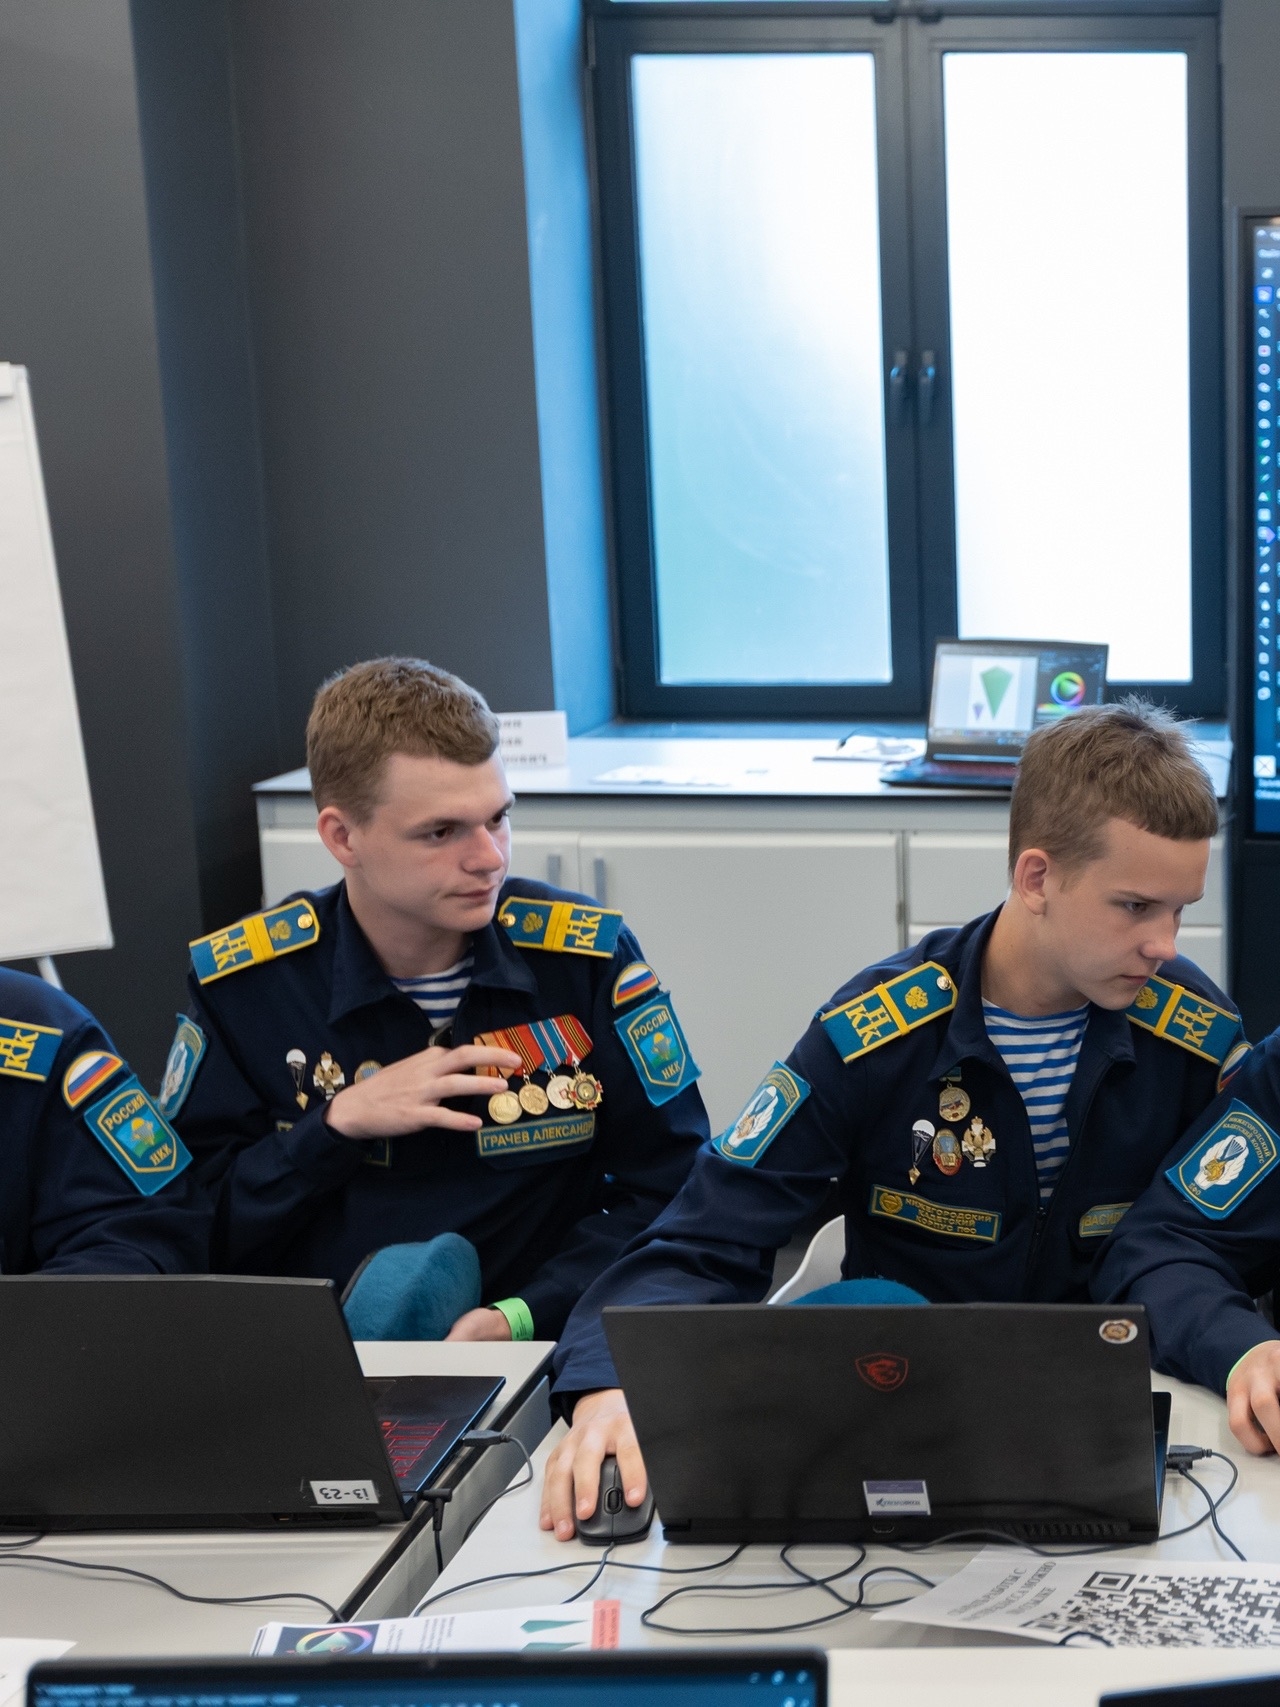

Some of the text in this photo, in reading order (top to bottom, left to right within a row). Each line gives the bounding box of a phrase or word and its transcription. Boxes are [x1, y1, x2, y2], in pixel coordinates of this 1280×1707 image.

[104, 1093, 148, 1131] РОССИЯ
[483, 1121, 594, 1149] ГРАЧЕВ АЛЕКСАНДР
[150, 1143, 174, 1166] НКК
[905, 1198, 992, 1222] НИЖЕГОРОДСКИЙ
[918, 1209, 976, 1226] КАДЕТСКИЙ
[916, 1215, 954, 1232] КОРПУС
